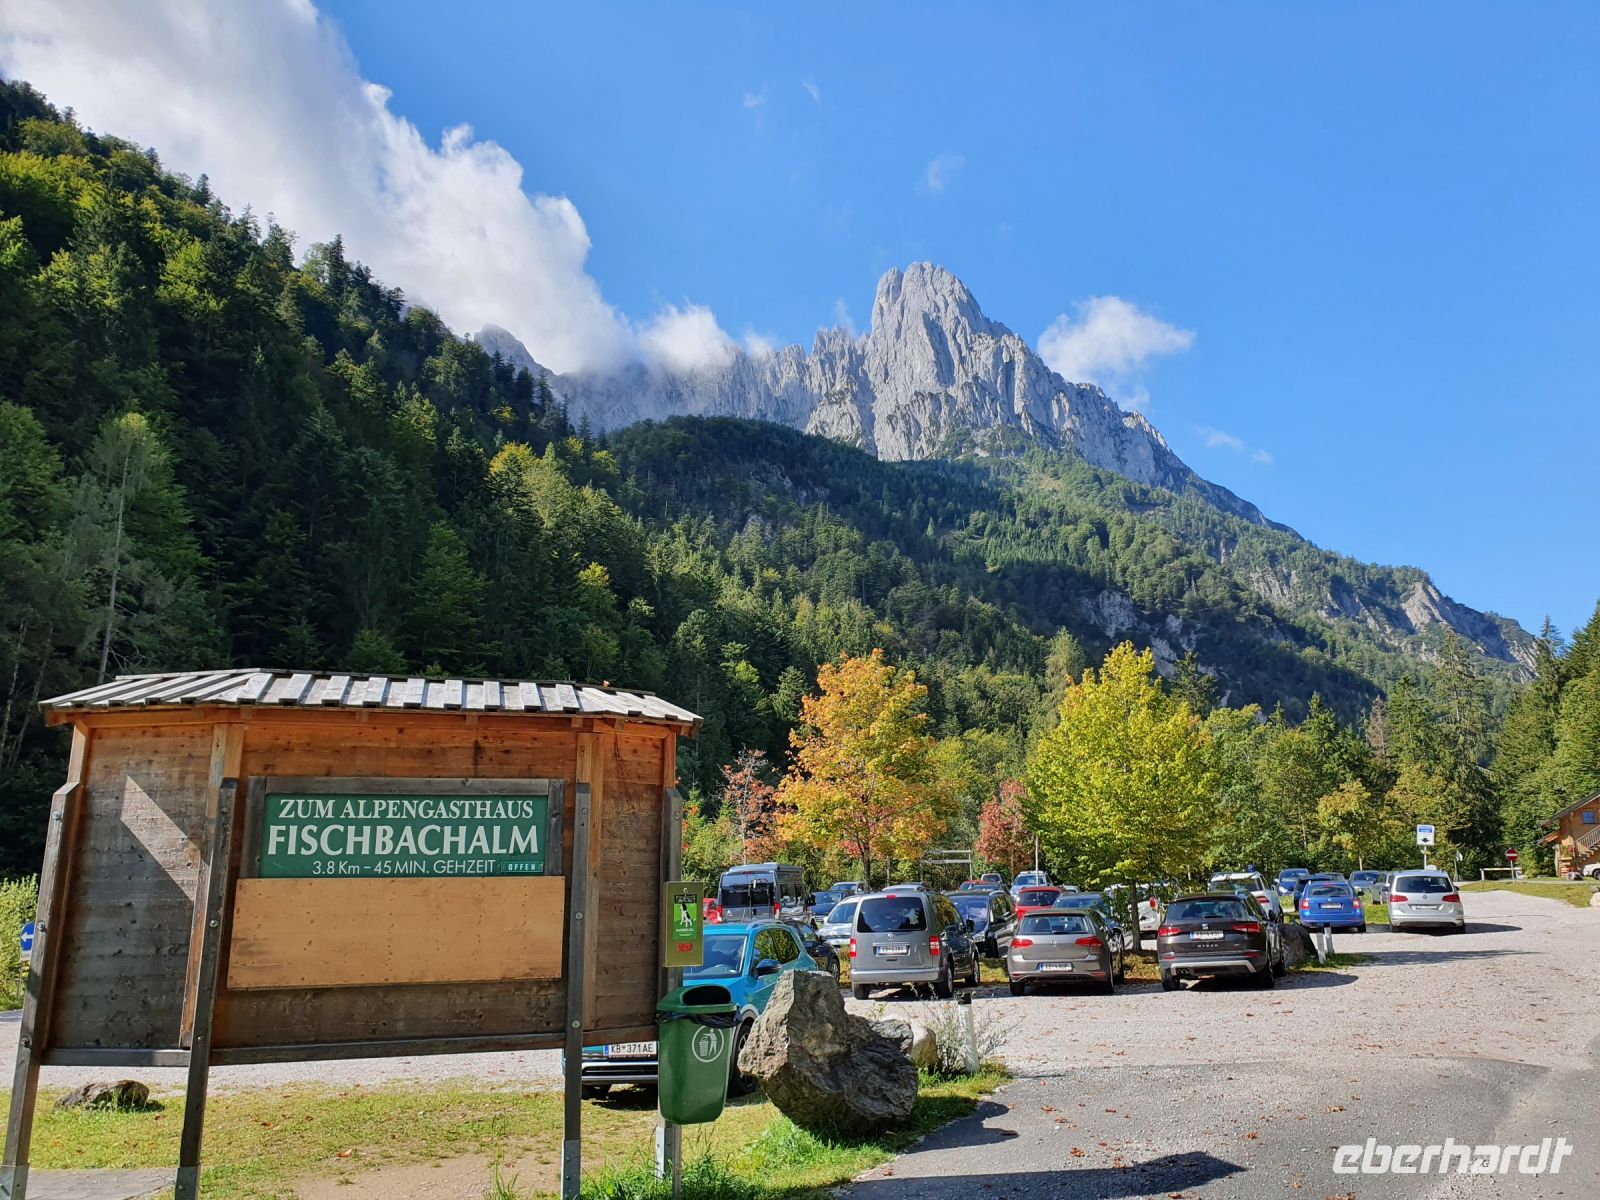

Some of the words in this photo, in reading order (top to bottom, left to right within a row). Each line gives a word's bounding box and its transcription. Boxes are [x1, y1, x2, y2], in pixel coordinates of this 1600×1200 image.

[278, 799, 335, 819] ZUM
[340, 799, 534, 819] ALPENGASTHAUS
[267, 824, 539, 856] FISCHBACHALM
[312, 861, 335, 875] 3.8
[339, 861, 360, 875] Km
[373, 860, 392, 875] 45
[394, 860, 430, 874] MIN.
[433, 859, 497, 874] GEHZEIT
[507, 863, 537, 871] OFFEN
